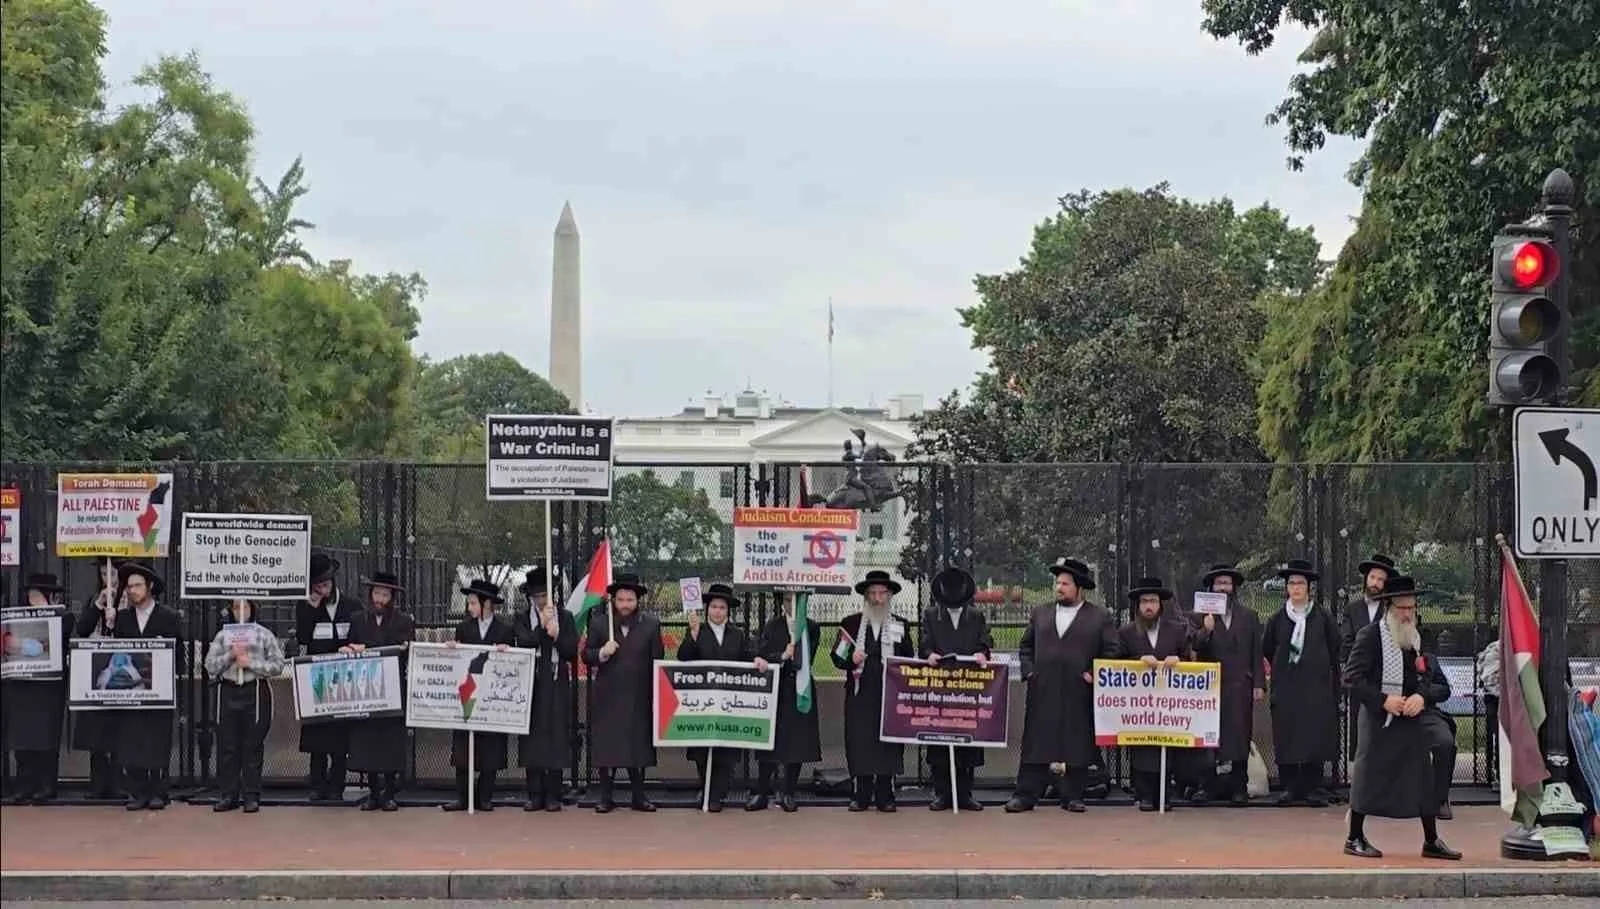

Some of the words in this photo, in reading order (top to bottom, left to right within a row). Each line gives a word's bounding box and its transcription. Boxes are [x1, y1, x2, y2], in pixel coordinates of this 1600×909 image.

[492, 424, 576, 439] Netanyahu
[581, 424, 594, 437] is
[599, 428, 609, 438] a
[500, 442, 532, 455] War
[536, 442, 600, 456] Criminal
[73, 479, 99, 488] Torah
[102, 479, 147, 488] Demands
[62, 498, 82, 511] ALL
[84, 498, 141, 511] PALESTINE
[86, 514, 109, 522] returned
[740, 510, 786, 522] Judaism
[789, 511, 852, 524] Condemns
[60, 526, 94, 535] Palestinian
[189, 520, 213, 528] Jews
[216, 520, 264, 528] worldwide
[266, 521, 303, 529] demand
[1532, 516, 1600, 543] ONLY
[195, 534, 220, 546] Stop
[225, 535, 241, 545] the
[244, 535, 296, 546] Genocide
[758, 530, 777, 540] the
[745, 544, 776, 553] State
[778, 543, 790, 553] of
[210, 552, 227, 564] Lift
[231, 553, 248, 564] the
[252, 554, 282, 567] Siege
[185, 571, 202, 582] End
[206, 572, 220, 582] the
[223, 572, 250, 583] whole
[252, 572, 306, 585] Occupation
[743, 569, 767, 581] And
[770, 570, 784, 581] its
[787, 570, 845, 583] Atrocities
[423, 664, 453, 672] FREEDOM
[900, 666, 920, 676] The
[922, 667, 950, 677] State
[953, 669, 963, 678] of
[965, 669, 994, 679] Israel
[674, 672, 703, 683] Free
[707, 672, 767, 686] Palestine
[909, 678, 928, 686] and
[930, 679, 943, 687] its
[947, 679, 984, 690] actions
[1098, 668, 1136, 687] State
[1142, 667, 1157, 687] of
[1162, 667, 1216, 690] "Israel"
[681, 692, 715, 711] عربية
[721, 694, 768, 712] فلسطين
[912, 693, 927, 701] not
[928, 692, 941, 702] the
[943, 693, 976, 704] solution,
[978, 694, 993, 704] but
[1097, 694, 1126, 708] does
[1130, 694, 1153, 707] not
[1156, 696, 1216, 711] represent
[1121, 711, 1154, 724] world
[1158, 713, 1191, 730] Jewry
[676, 722, 762, 736] www.nkusa.org
[1126, 736, 1188, 744] www.NKUSA.org
